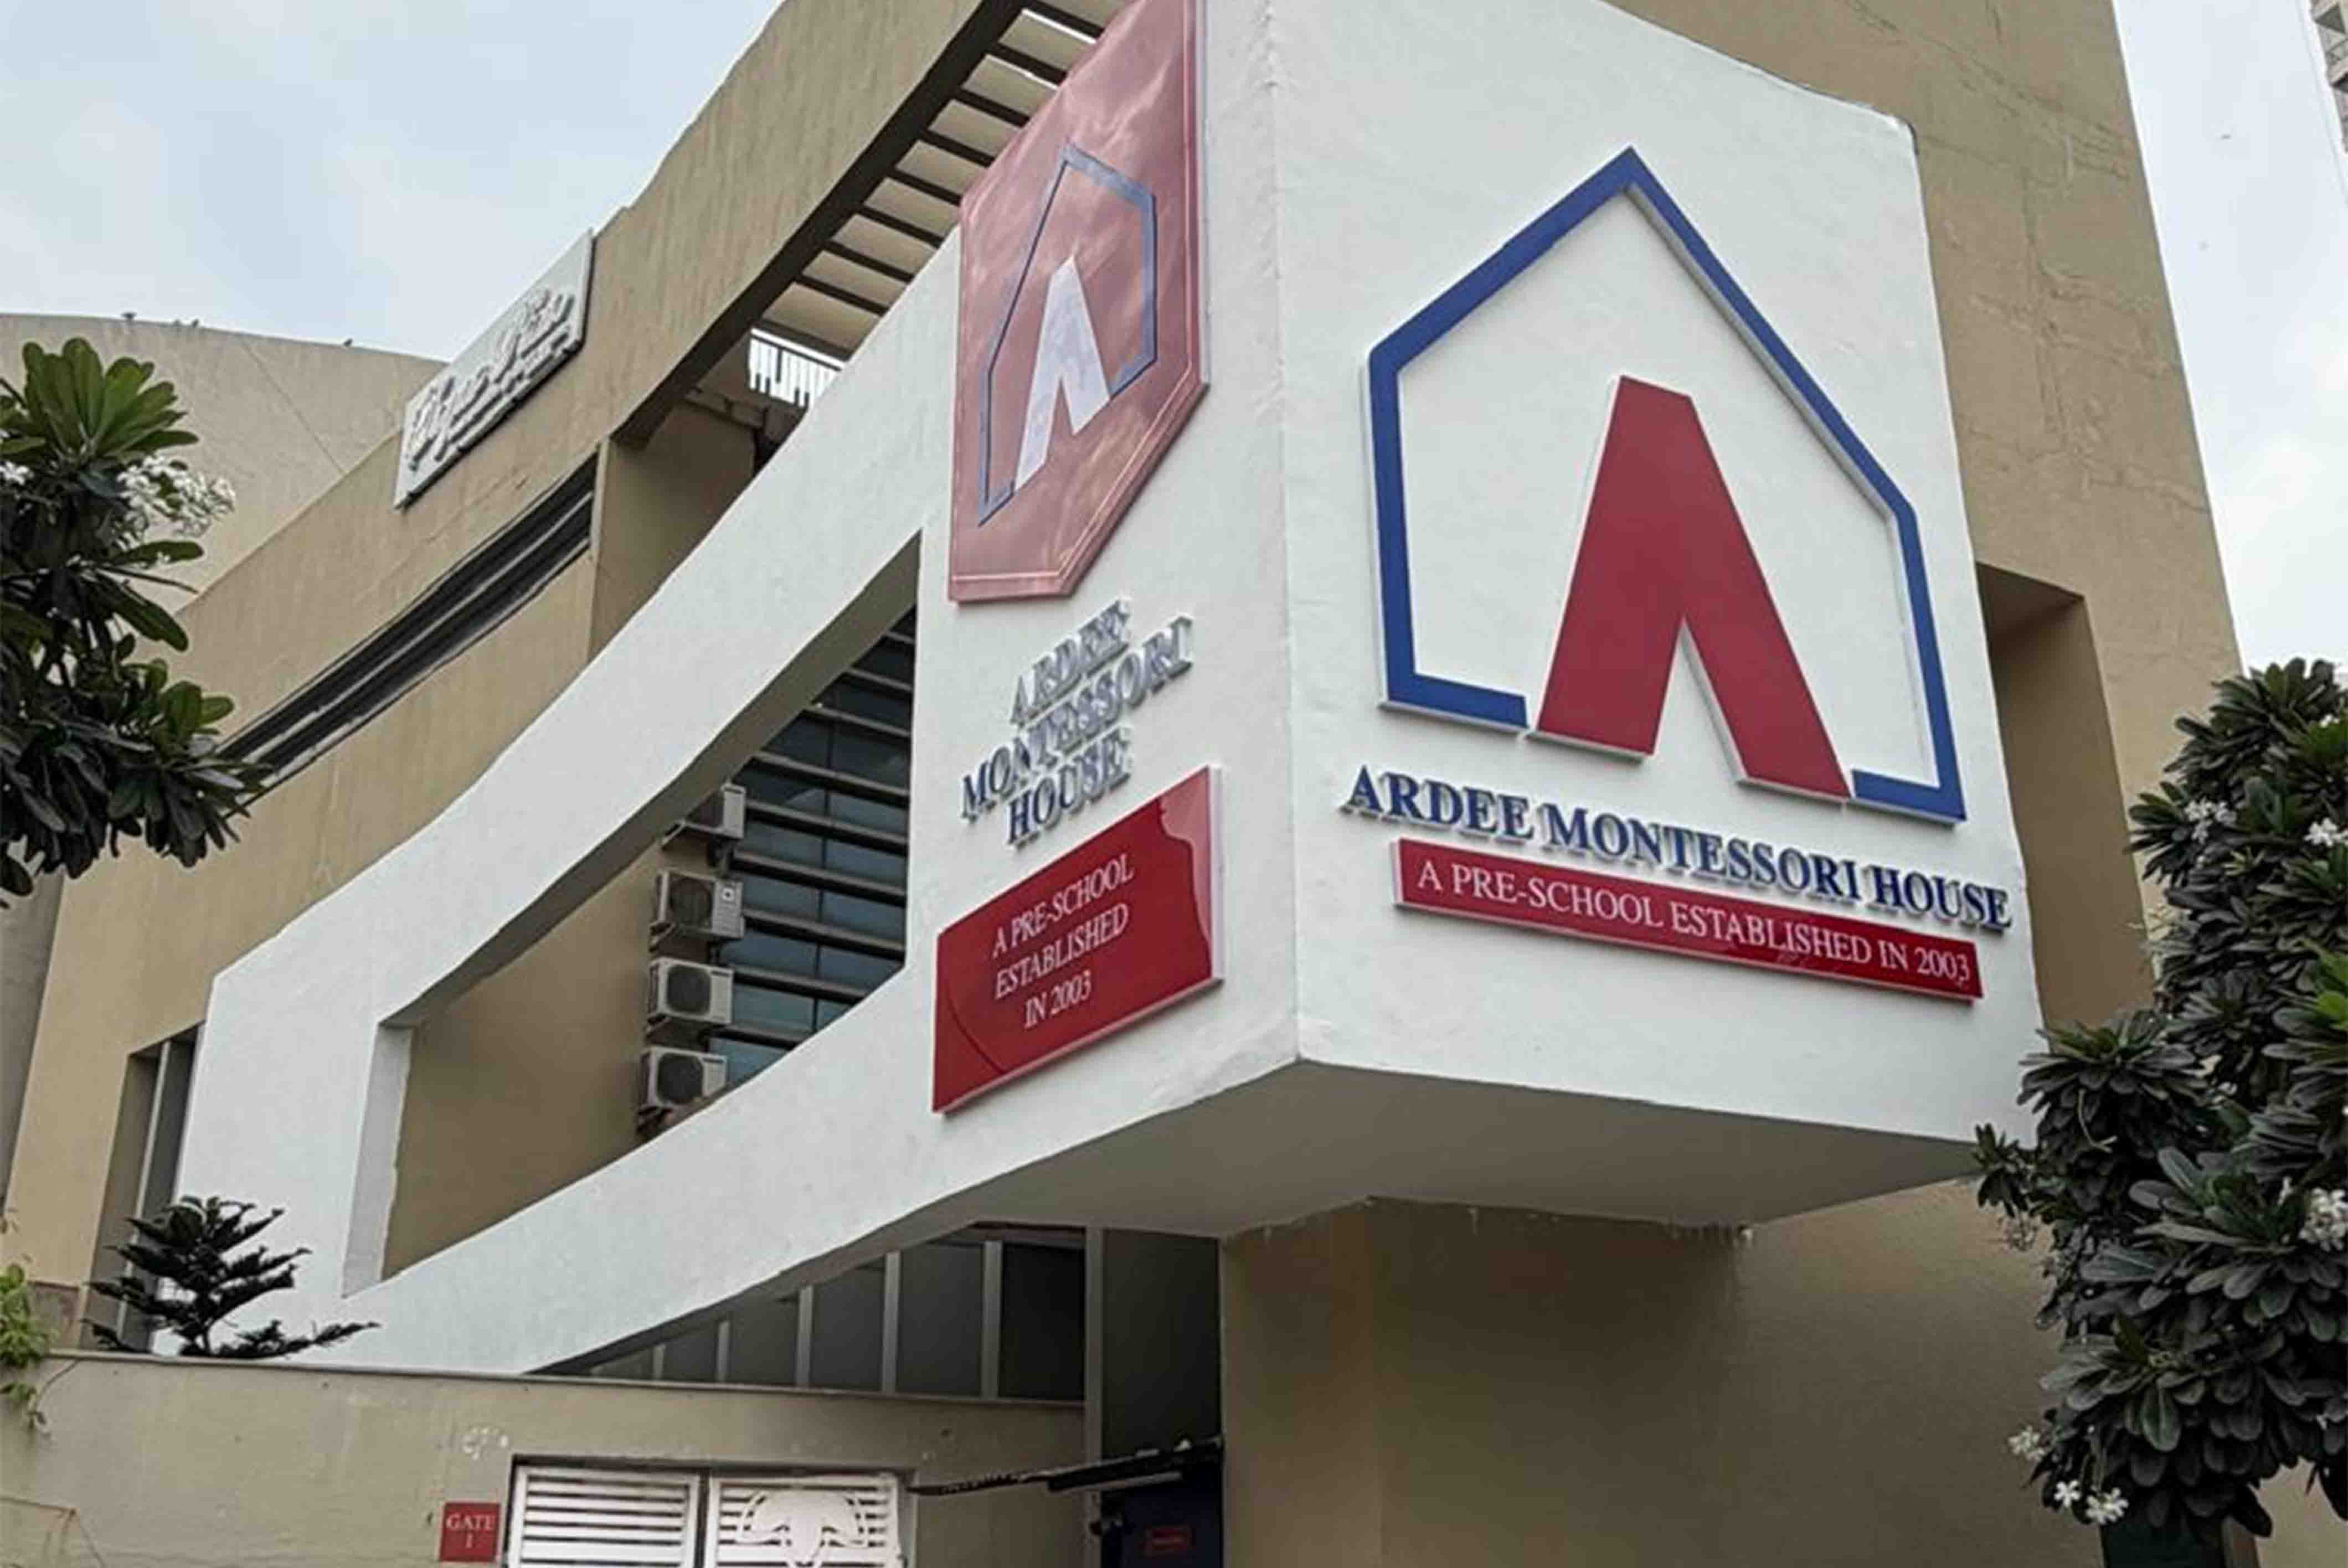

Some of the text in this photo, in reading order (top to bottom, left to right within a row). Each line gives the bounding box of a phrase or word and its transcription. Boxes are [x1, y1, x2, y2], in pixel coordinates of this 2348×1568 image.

[961, 616, 1194, 822] MONTESSORI
[1010, 597, 1131, 727] ARDEE
[1007, 725, 1131, 848] HOUSE
[992, 853, 1134, 958] A PRE-SCHOOL
[1340, 765, 2012, 935] ARDEE MONTESSORI HOUSE
[995, 903, 1129, 999] ESTABLISHED
[1418, 862, 1970, 983] A PRE-SCHOOL ESTABLISHED IN 2003
[1024, 970, 1091, 1028] IN 2003
[446, 1513, 495, 1531] GATE
